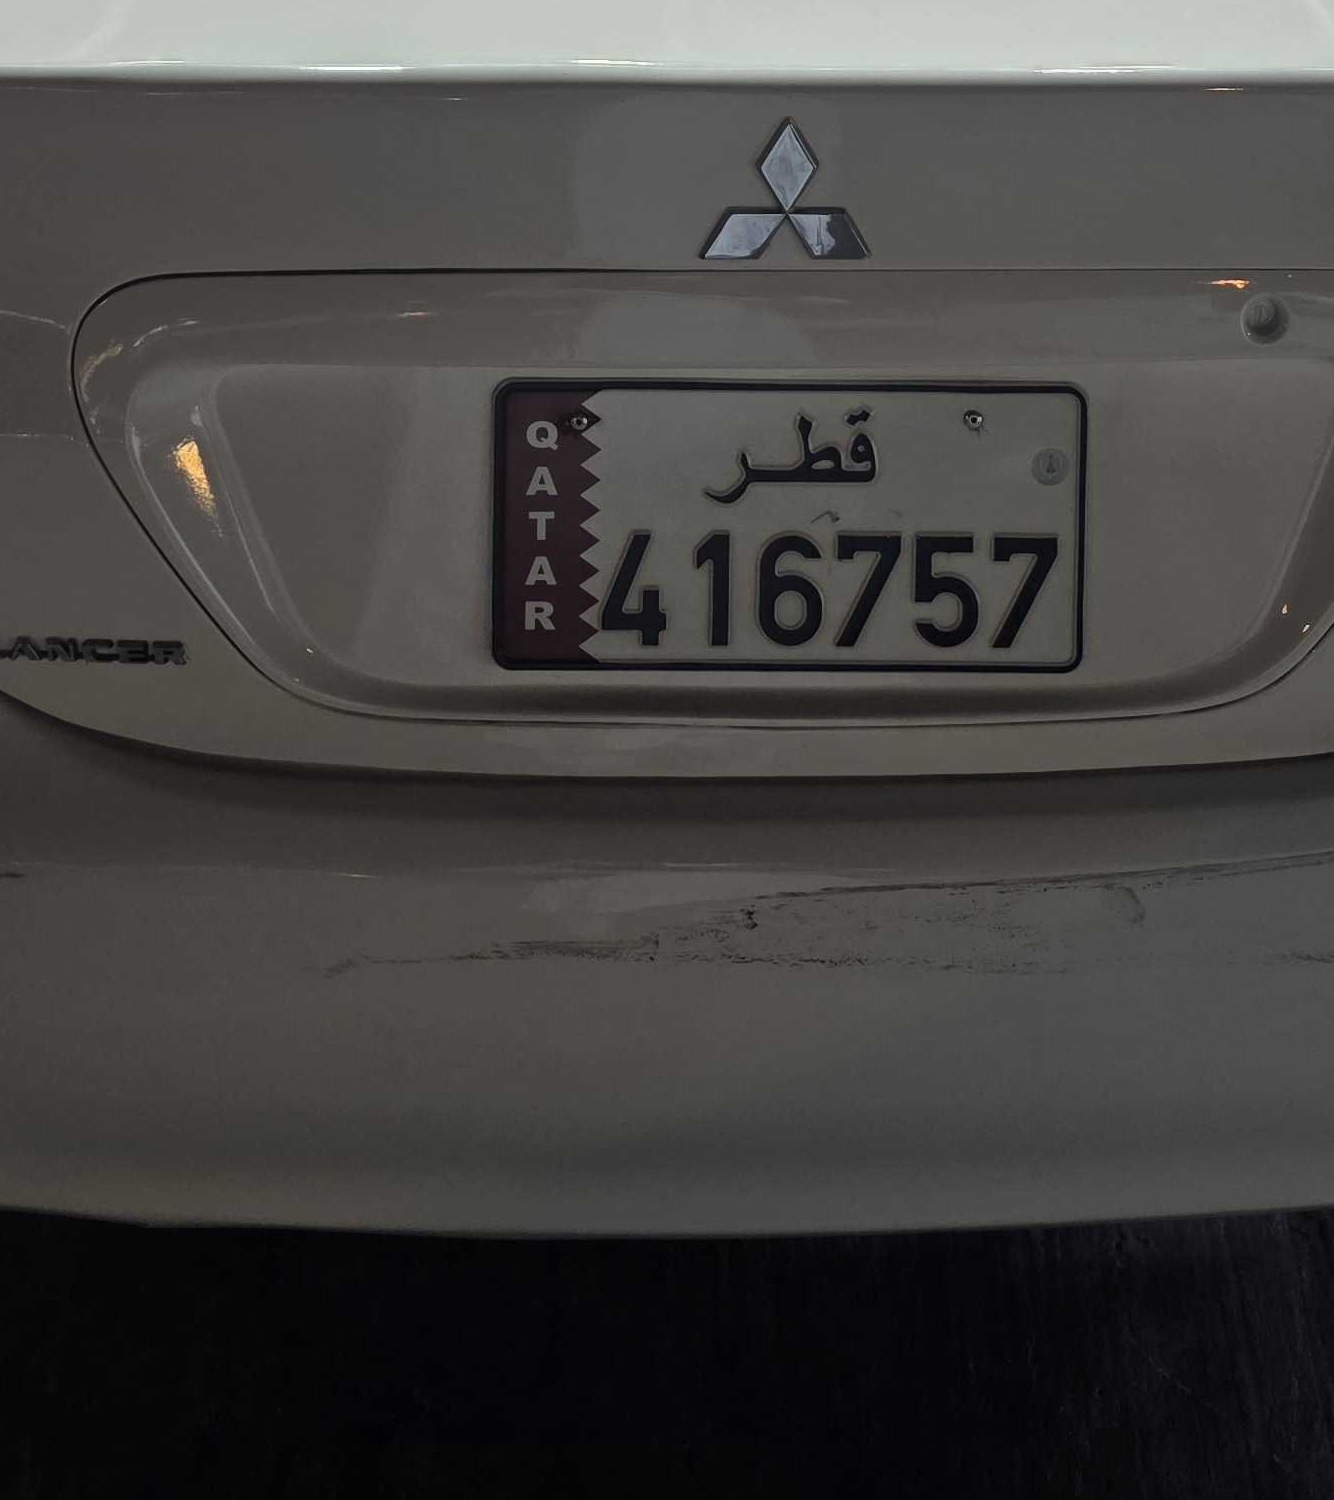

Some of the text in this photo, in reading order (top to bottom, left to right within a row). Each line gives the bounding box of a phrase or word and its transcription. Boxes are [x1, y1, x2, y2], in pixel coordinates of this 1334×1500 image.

[702, 407, 878, 505] قطر
[523, 419, 561, 632] QATAR
[600, 530, 1060, 649] 416757
